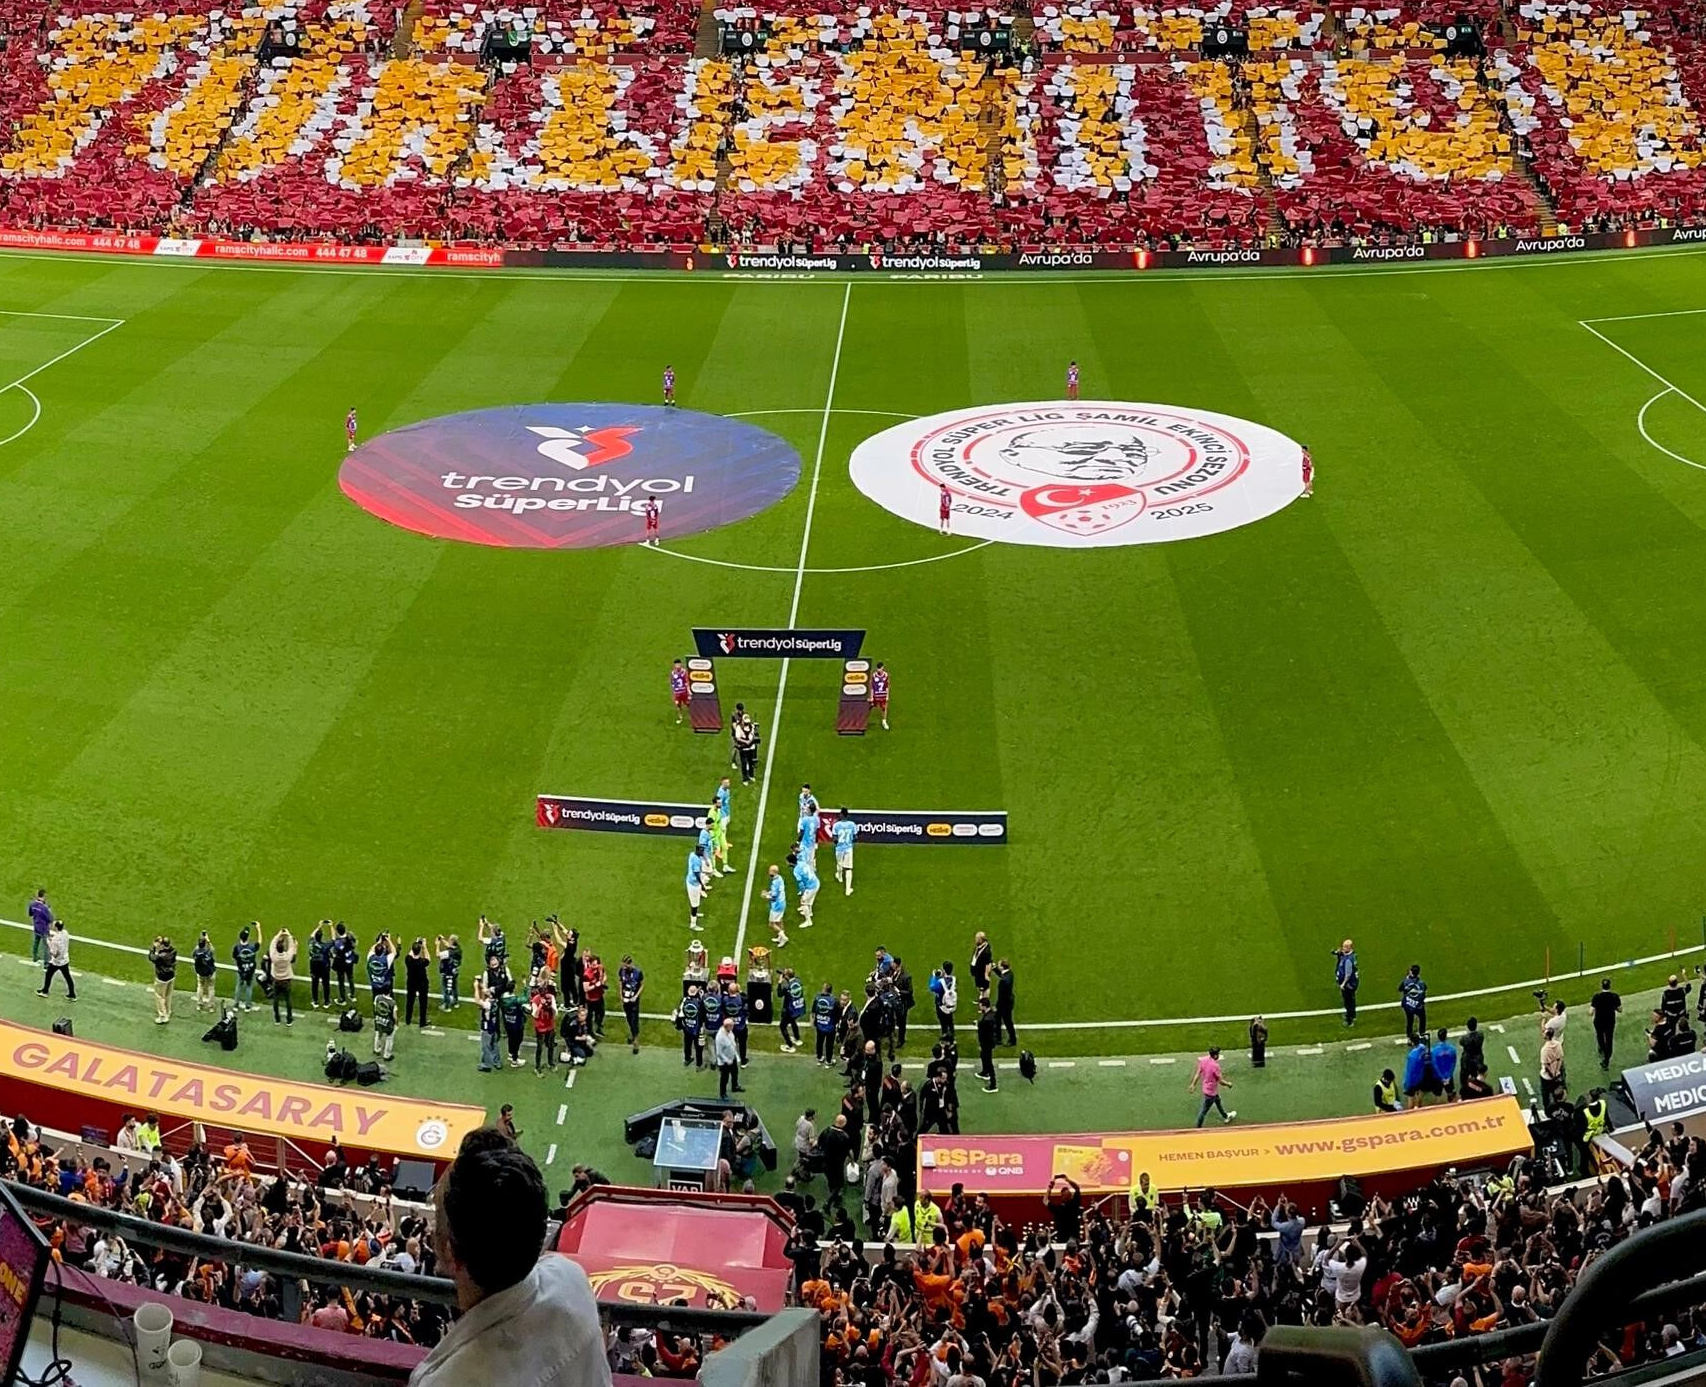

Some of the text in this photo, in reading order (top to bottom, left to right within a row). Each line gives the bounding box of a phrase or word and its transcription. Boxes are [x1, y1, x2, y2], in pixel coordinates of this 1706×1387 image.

[94, 236, 111, 247] 444
[113, 237, 125, 248] 47
[128, 239, 139, 249] 48
[1516, 237, 1585, 252] Avrupa'da
[215, 244, 367, 259] ramscityhalic.com 444 47 48
[1018, 252, 1092, 267] Avrupa'da
[1187, 249, 1260, 264] Avrupa'da
[1353, 245, 1424, 261] Avrupa'da
[739, 254, 795, 270] trendyol
[882, 254, 939, 270] trendyol
[1020, 411, 1064, 422] LİG
[942, 418, 1015, 445] SÜPER
[1169, 423, 1233, 455] EKİNCİ
[933, 446, 1010, 497] TRENDYOL
[1158, 455, 1228, 496] SEZONU
[441, 471, 694, 494] trendyol
[953, 503, 1013, 520] 2024
[1150, 502, 1214, 521] 2025
[737, 637, 794, 651] trendyol
[562, 808, 605, 822] trendyol
[838, 827, 853, 841] 27
[857, 822, 886, 833] ndyol
[12, 1042, 389, 1136] GALATASARAY
[1275, 1114, 1506, 1156] www.gspara.com.tr
[934, 1148, 1024, 1167] GSPara
[1159, 1147, 1259, 1162] HEMEN BAŞVUR
